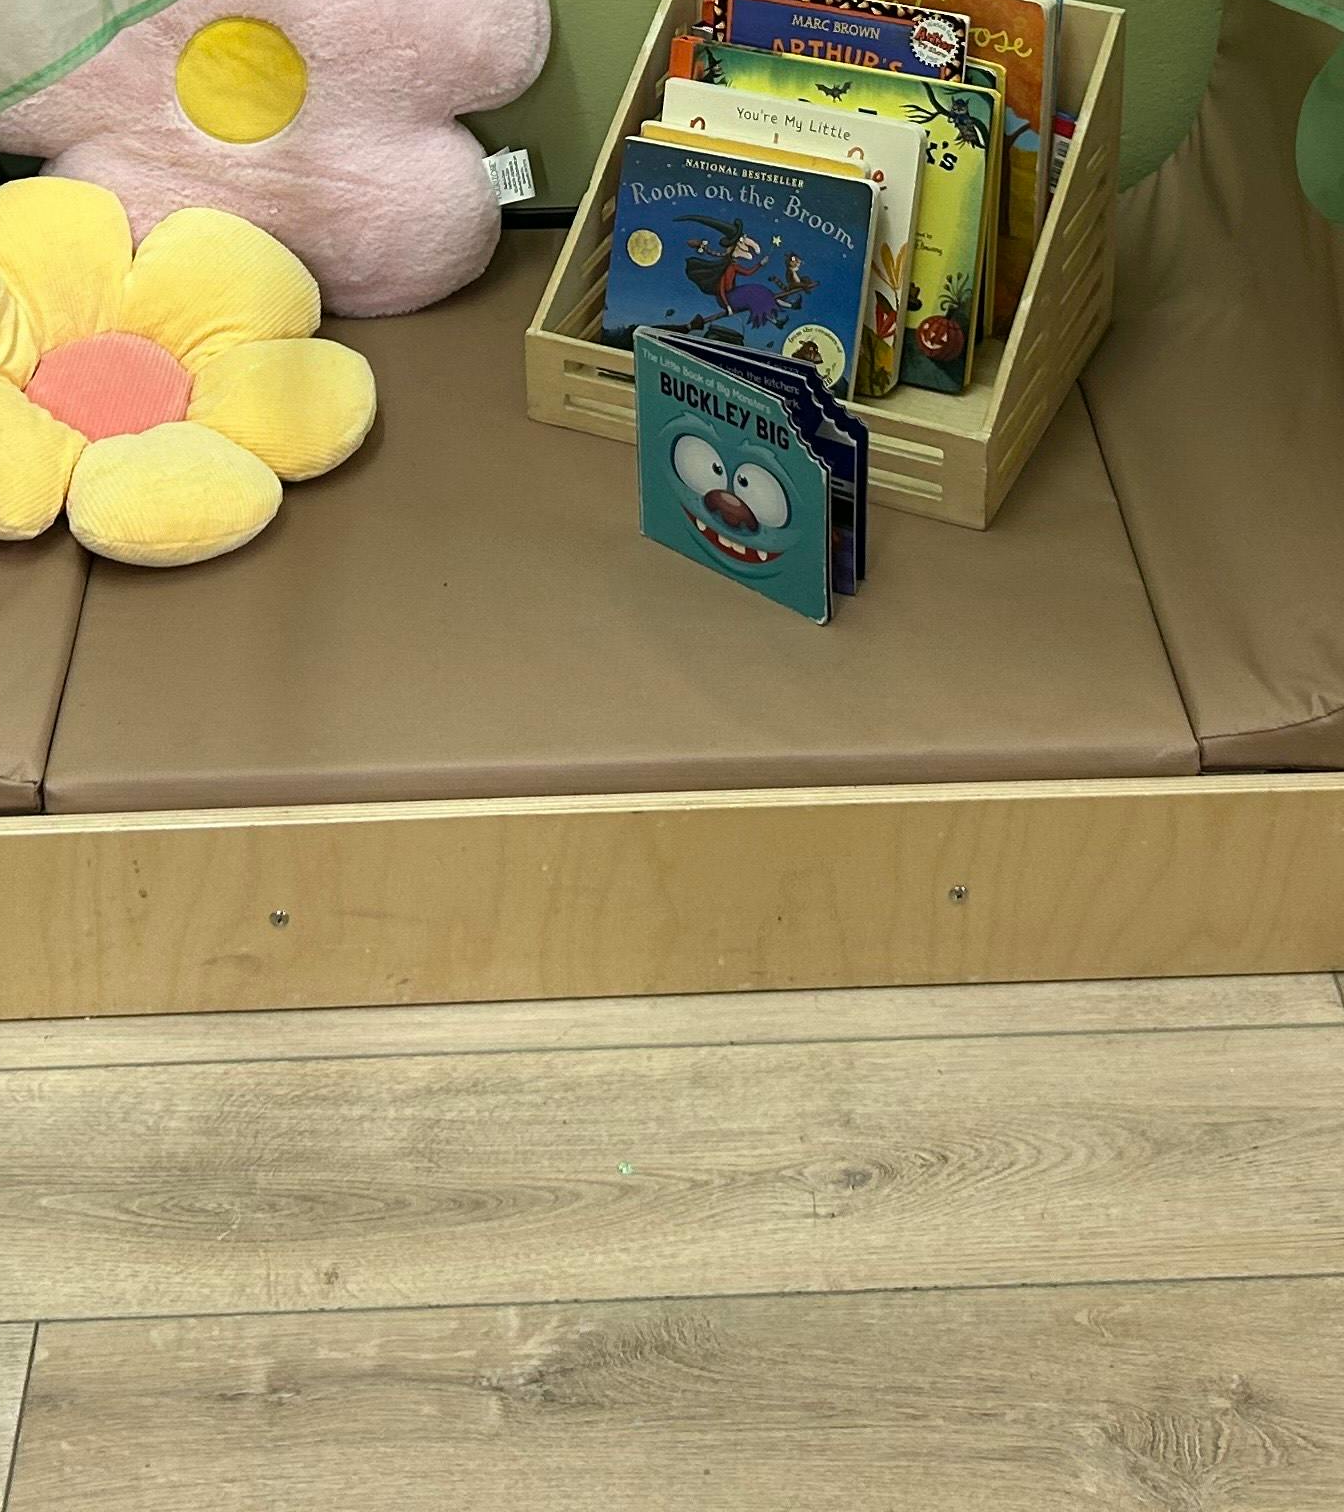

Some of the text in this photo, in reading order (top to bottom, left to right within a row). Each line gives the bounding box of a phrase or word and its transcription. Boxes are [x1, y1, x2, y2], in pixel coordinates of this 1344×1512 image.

[791, 14, 880, 40] MARC BROWN
[737, 106, 777, 124] You're
[785, 114, 802, 132] My
[809, 119, 851, 141] Little
[685, 158, 804, 188] NATIONAL BESTSELLER
[631, 182, 855, 250] Room on the Broom
[659, 356, 681, 373] Little
[660, 371, 789, 450] BUCKLEY BIG
